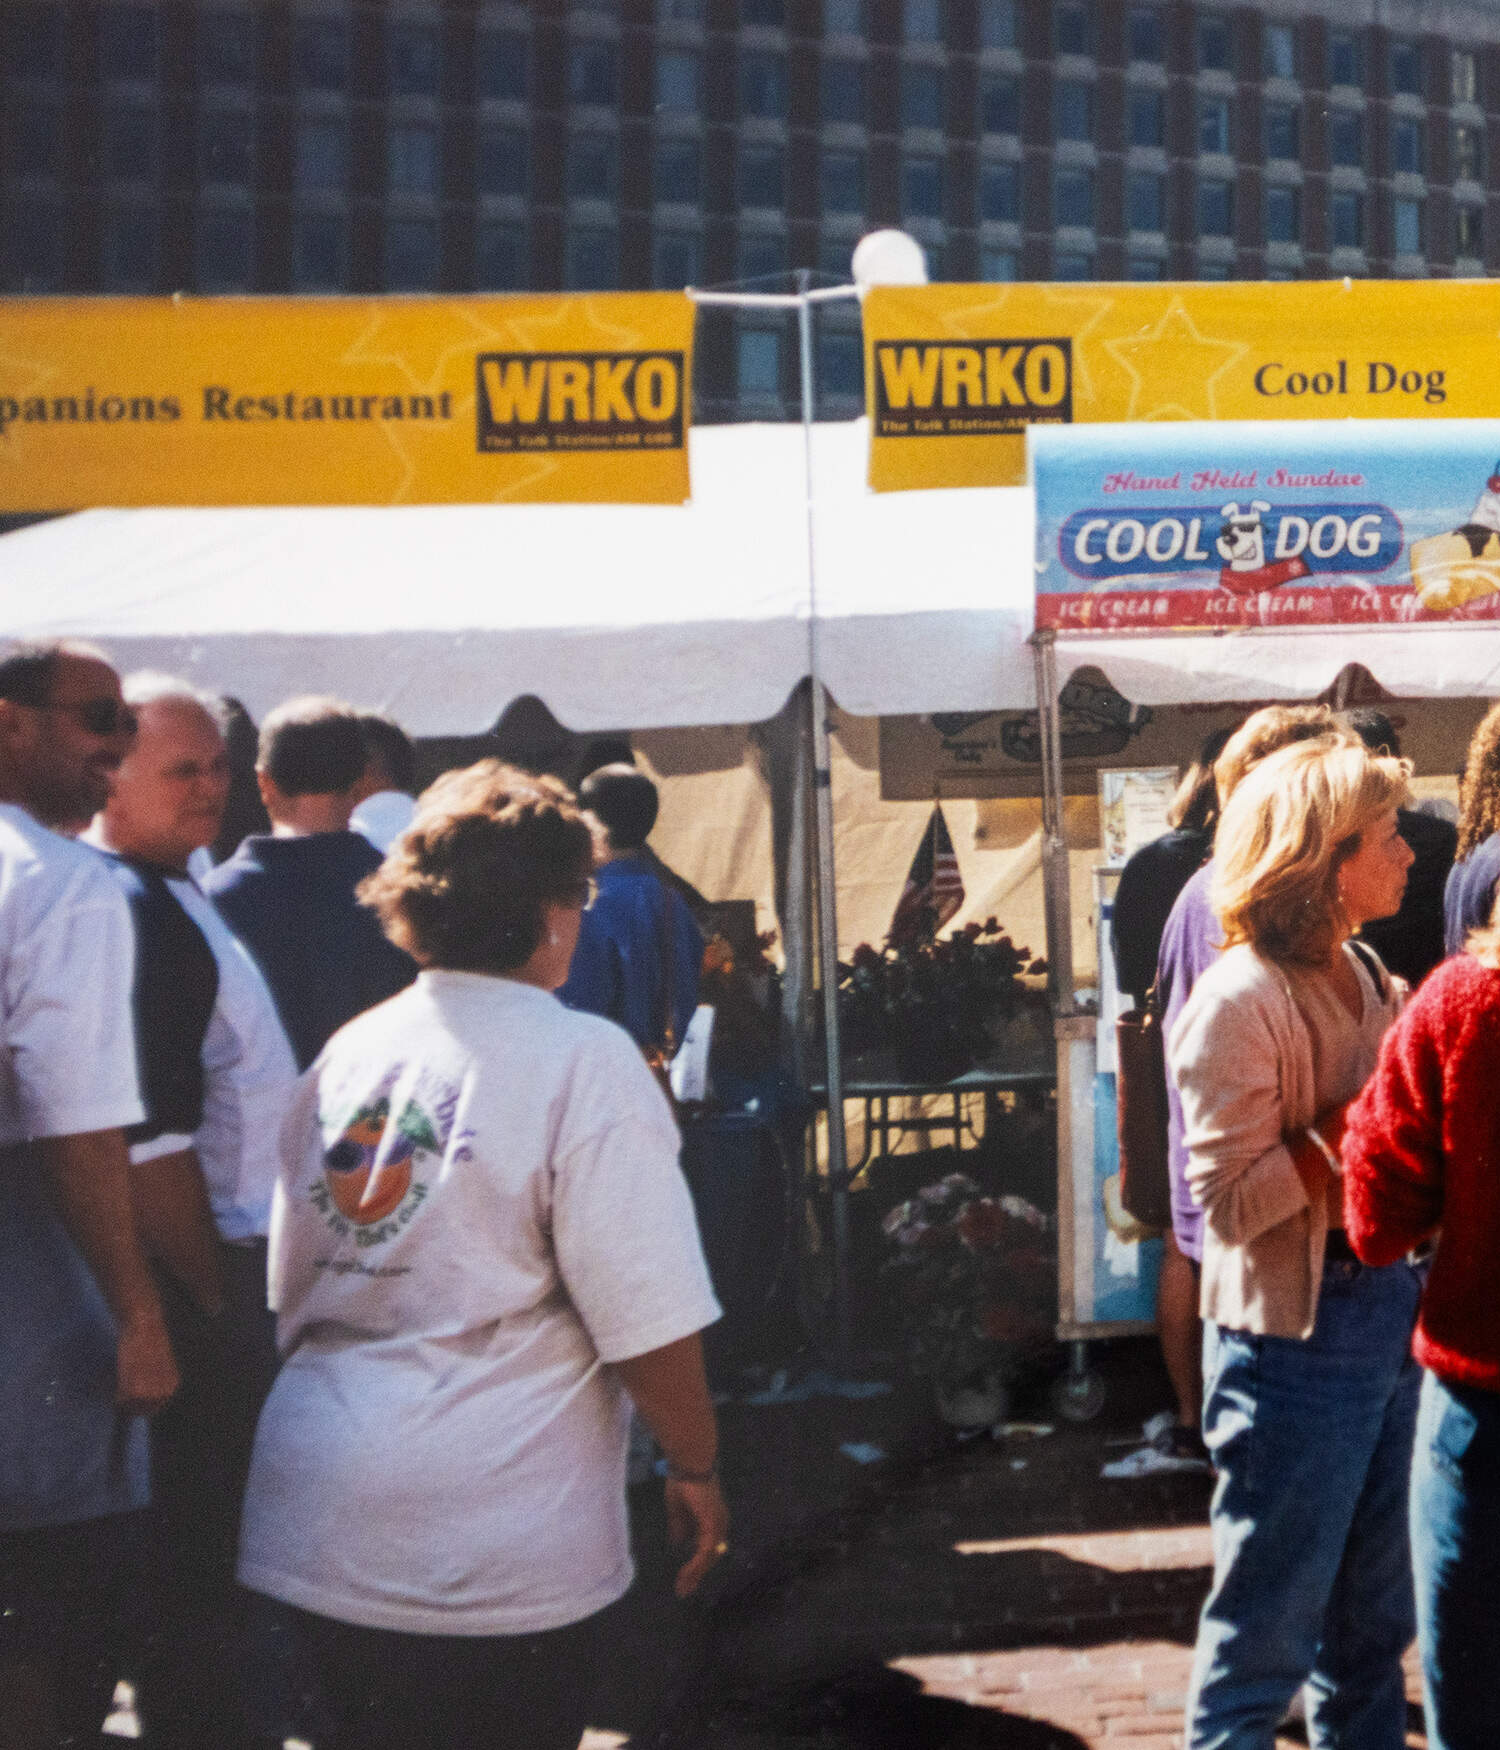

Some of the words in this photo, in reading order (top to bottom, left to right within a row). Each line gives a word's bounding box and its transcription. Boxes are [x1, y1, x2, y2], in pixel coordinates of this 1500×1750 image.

[482, 357, 678, 424] WRKO
[879, 344, 1067, 409] WRKO
[1254, 359, 1348, 397] Cool
[1367, 361, 1447, 405] Dog
[0, 386, 182, 435] panions
[203, 386, 454, 422] Restaurant
[1102, 470, 1181, 494] Hand
[1190, 469, 1258, 492] Held
[1266, 467, 1364, 489] Sundae
[1074, 518, 1210, 565] COOL
[1274, 514, 1384, 559] DOG
[1099, 598, 1169, 617] CREAM
[1205, 596, 1238, 614] ICE
